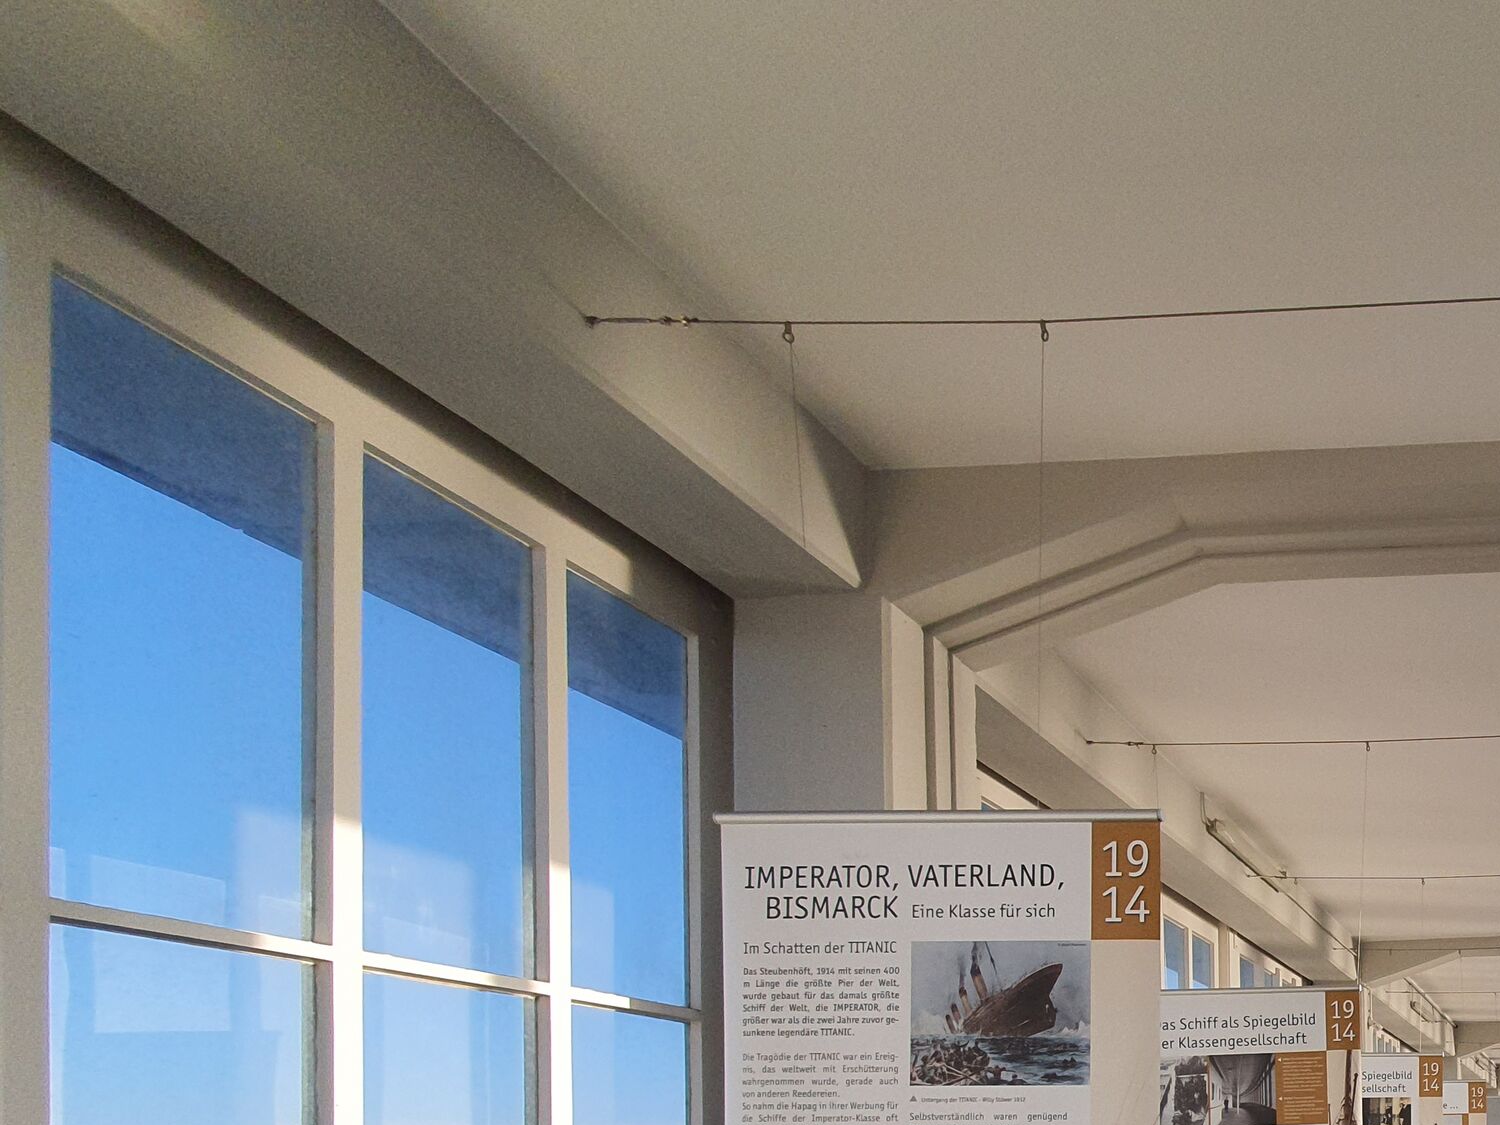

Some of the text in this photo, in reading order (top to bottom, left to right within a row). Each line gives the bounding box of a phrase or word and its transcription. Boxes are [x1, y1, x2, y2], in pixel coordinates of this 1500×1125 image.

[1102, 839, 1151, 879] 19
[744, 863, 1065, 891] IMPERATOR, VATERLAND,
[765, 895, 1055, 919] BISMARCK Eine Klasse für sich
[1102, 885, 1151, 925] 14
[743, 940, 897, 954] Im Schatten der TITANIC
[742, 966, 900, 977] Das Steubenhöft, 1914 mit seinen 400
[755, 979, 780, 989] Länge
[785, 978, 798, 987] die
[803, 978, 832, 989] größte
[837, 978, 853, 987] Pier
[859, 978, 872, 987] der
[878, 978, 900, 988] Welt,
[742, 1002, 899, 1013] Schiff der Welt, die IMPERATOR, die
[1330, 999, 1355, 1019] 19
[1160, 1012, 1318, 1031] as Schiff als Spiegelbild
[742, 1027, 855, 1038] sunkene legendäre TITANIC.
[1331, 1022, 1356, 1043] 14
[1178, 1031, 1308, 1050] Klassengesellschaft
[1361, 1070, 1413, 1082] Spiegelbild
[1422, 1062, 1439, 1076] 19
[1361, 1083, 1407, 1093] sellschaft
[1422, 1078, 1440, 1093] 14
[909, 1112, 984, 1121] Selbstverständlich
[1026, 1112, 1068, 1122] genügend
